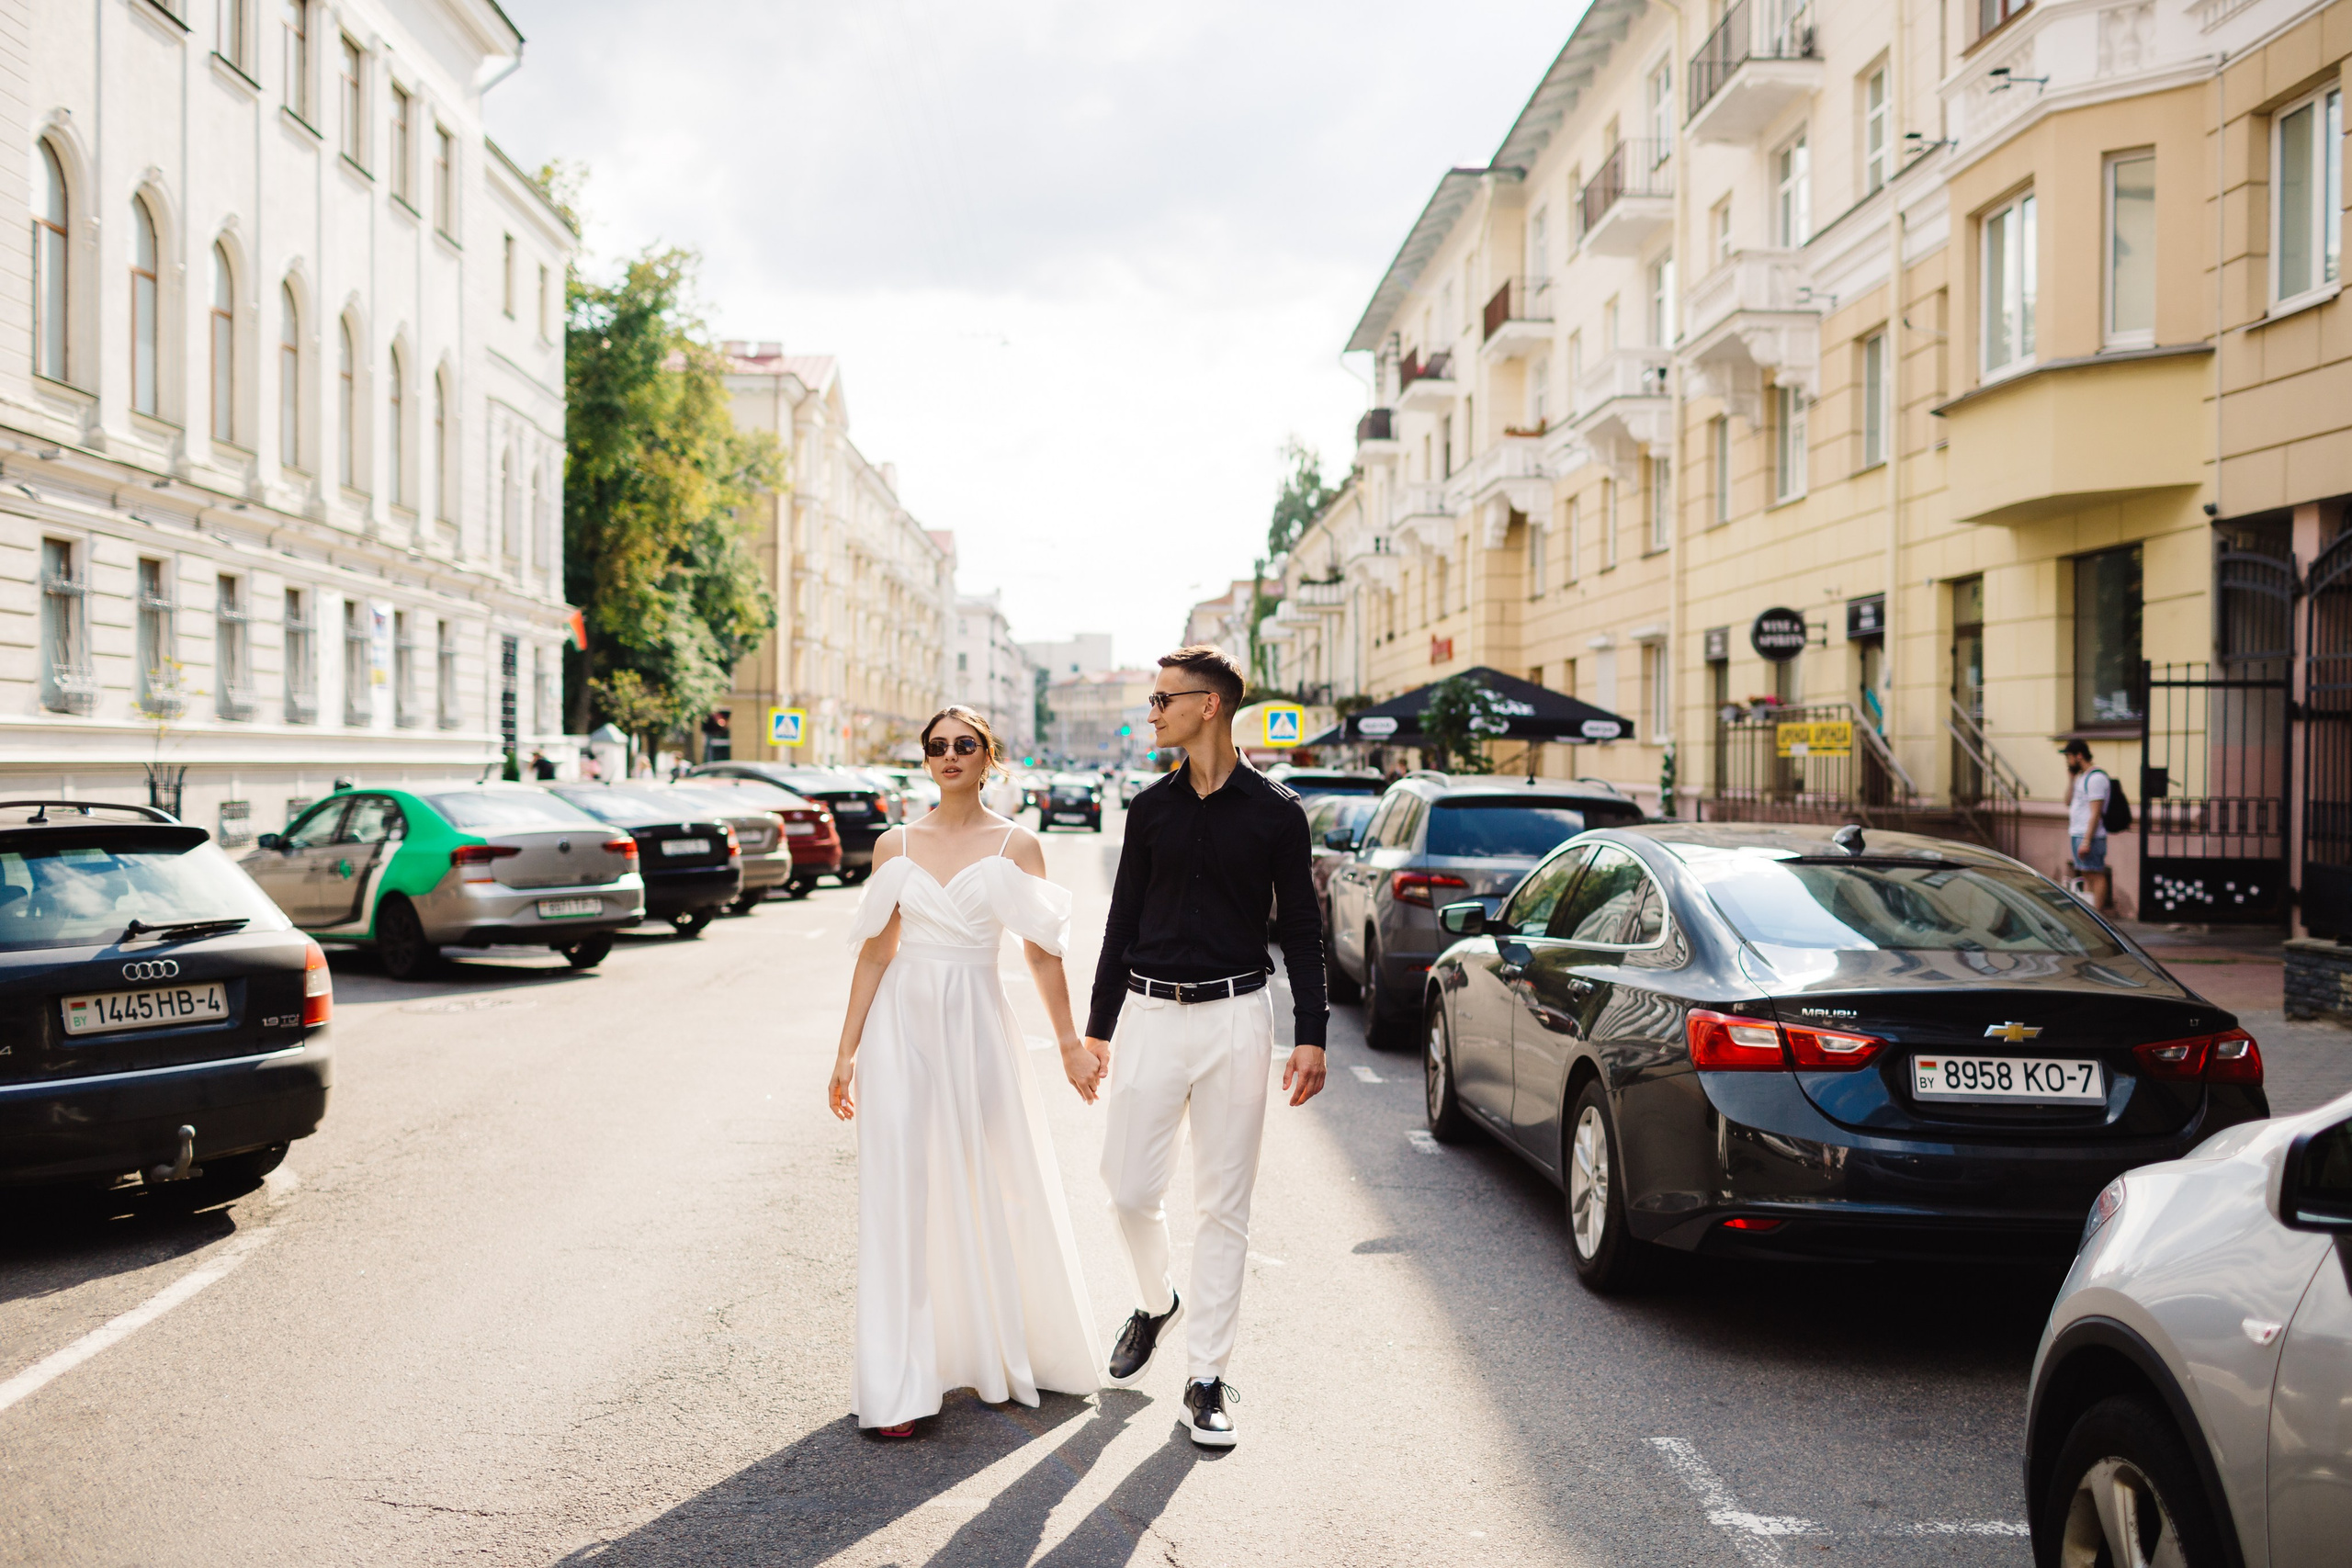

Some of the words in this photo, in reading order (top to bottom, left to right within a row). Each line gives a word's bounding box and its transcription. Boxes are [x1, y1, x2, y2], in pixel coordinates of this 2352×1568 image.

[1802, 1008, 1857, 1019] MALIBU
[74, 1016, 87, 1027] BY
[1944, 1060, 2013, 1091] 8958
[1919, 1077, 1934, 1089] BY
